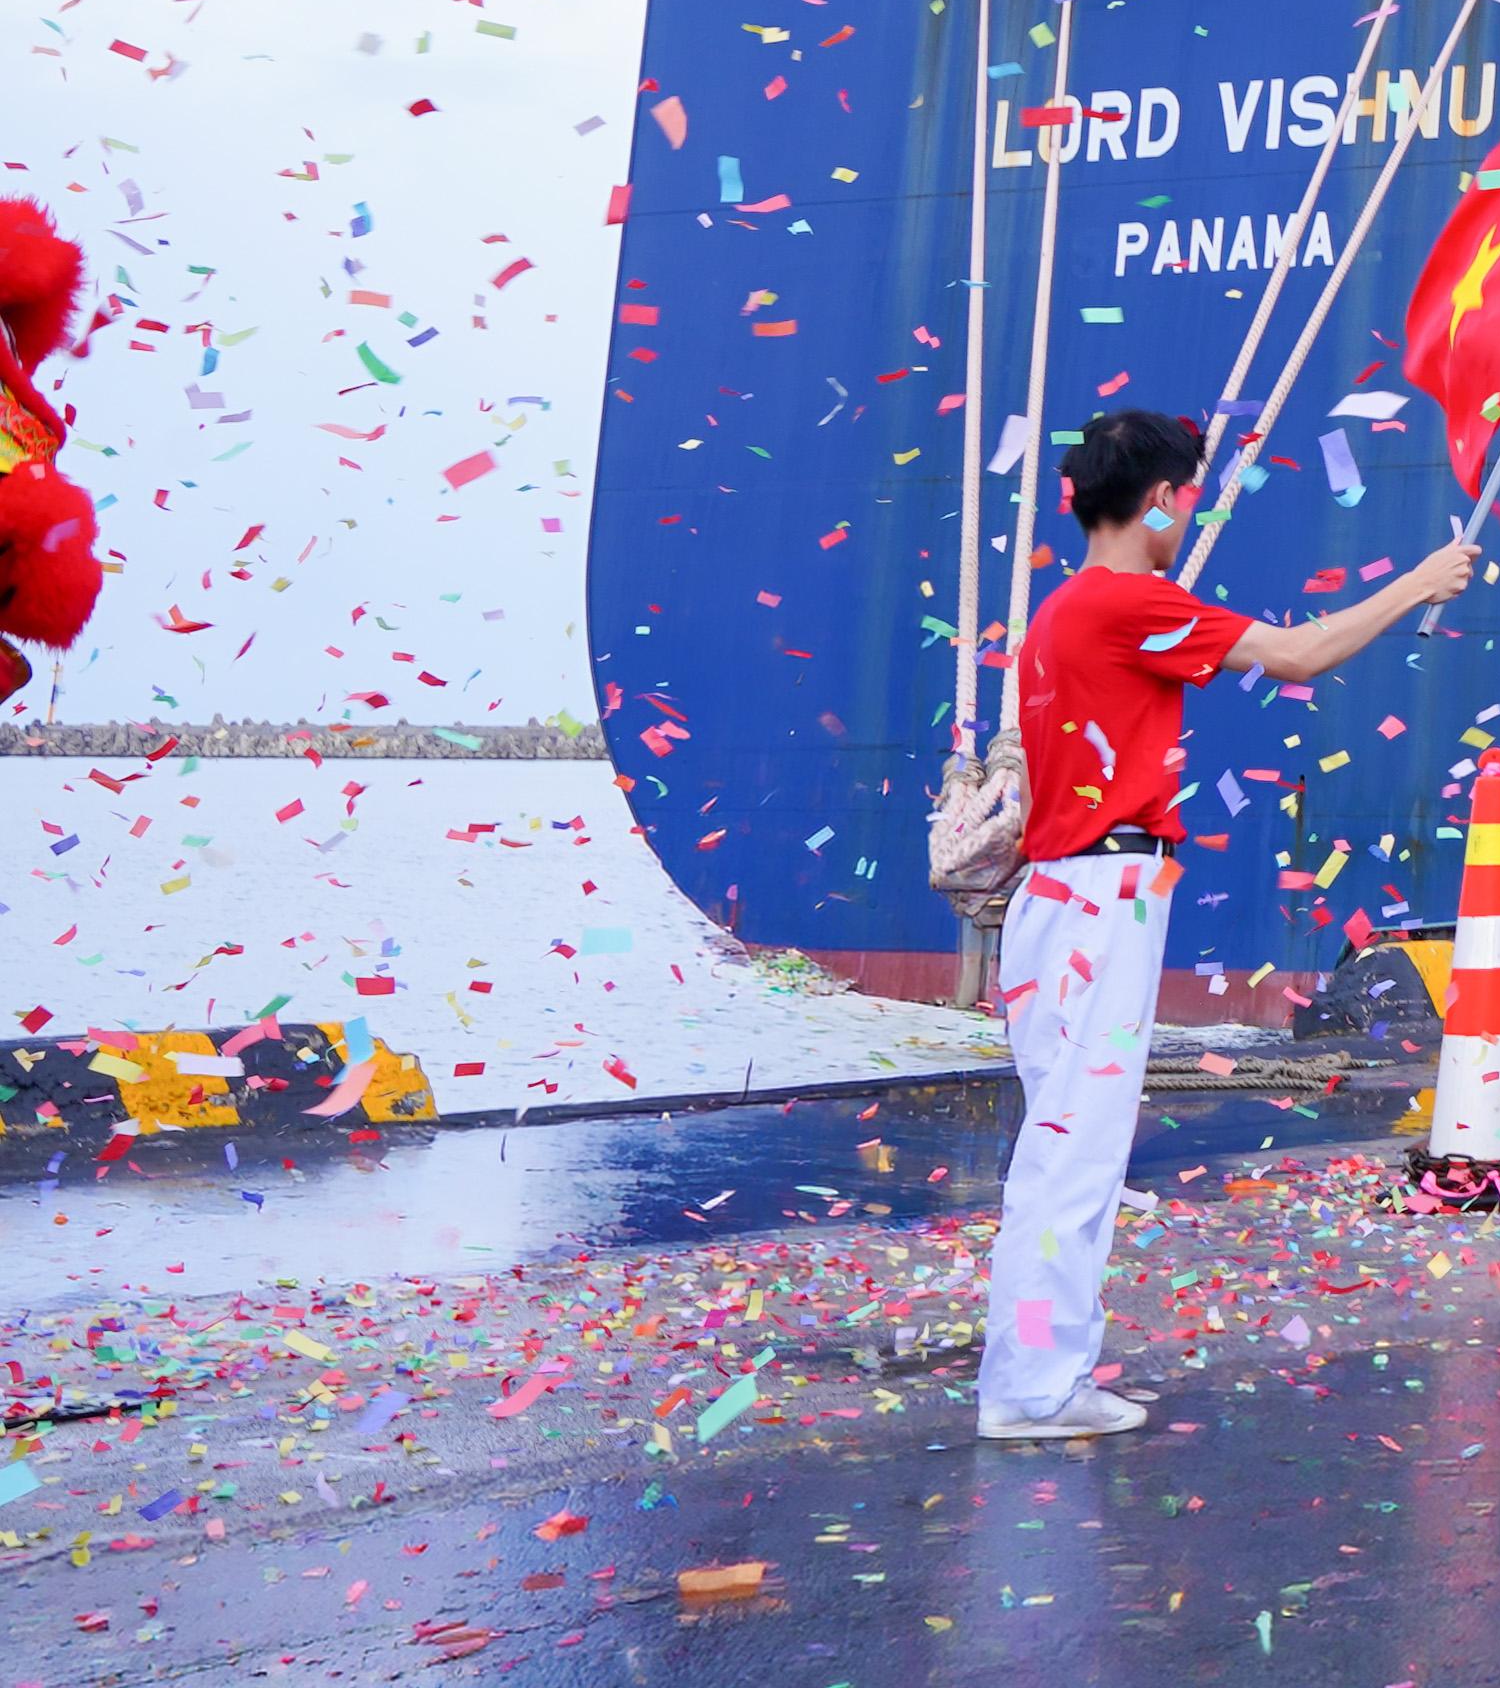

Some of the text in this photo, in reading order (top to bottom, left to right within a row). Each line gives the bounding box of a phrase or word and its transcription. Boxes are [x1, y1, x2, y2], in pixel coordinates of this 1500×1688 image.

[991, 62, 1497, 170] LORD VISHNU
[1114, 211, 1336, 277] PANAMA
